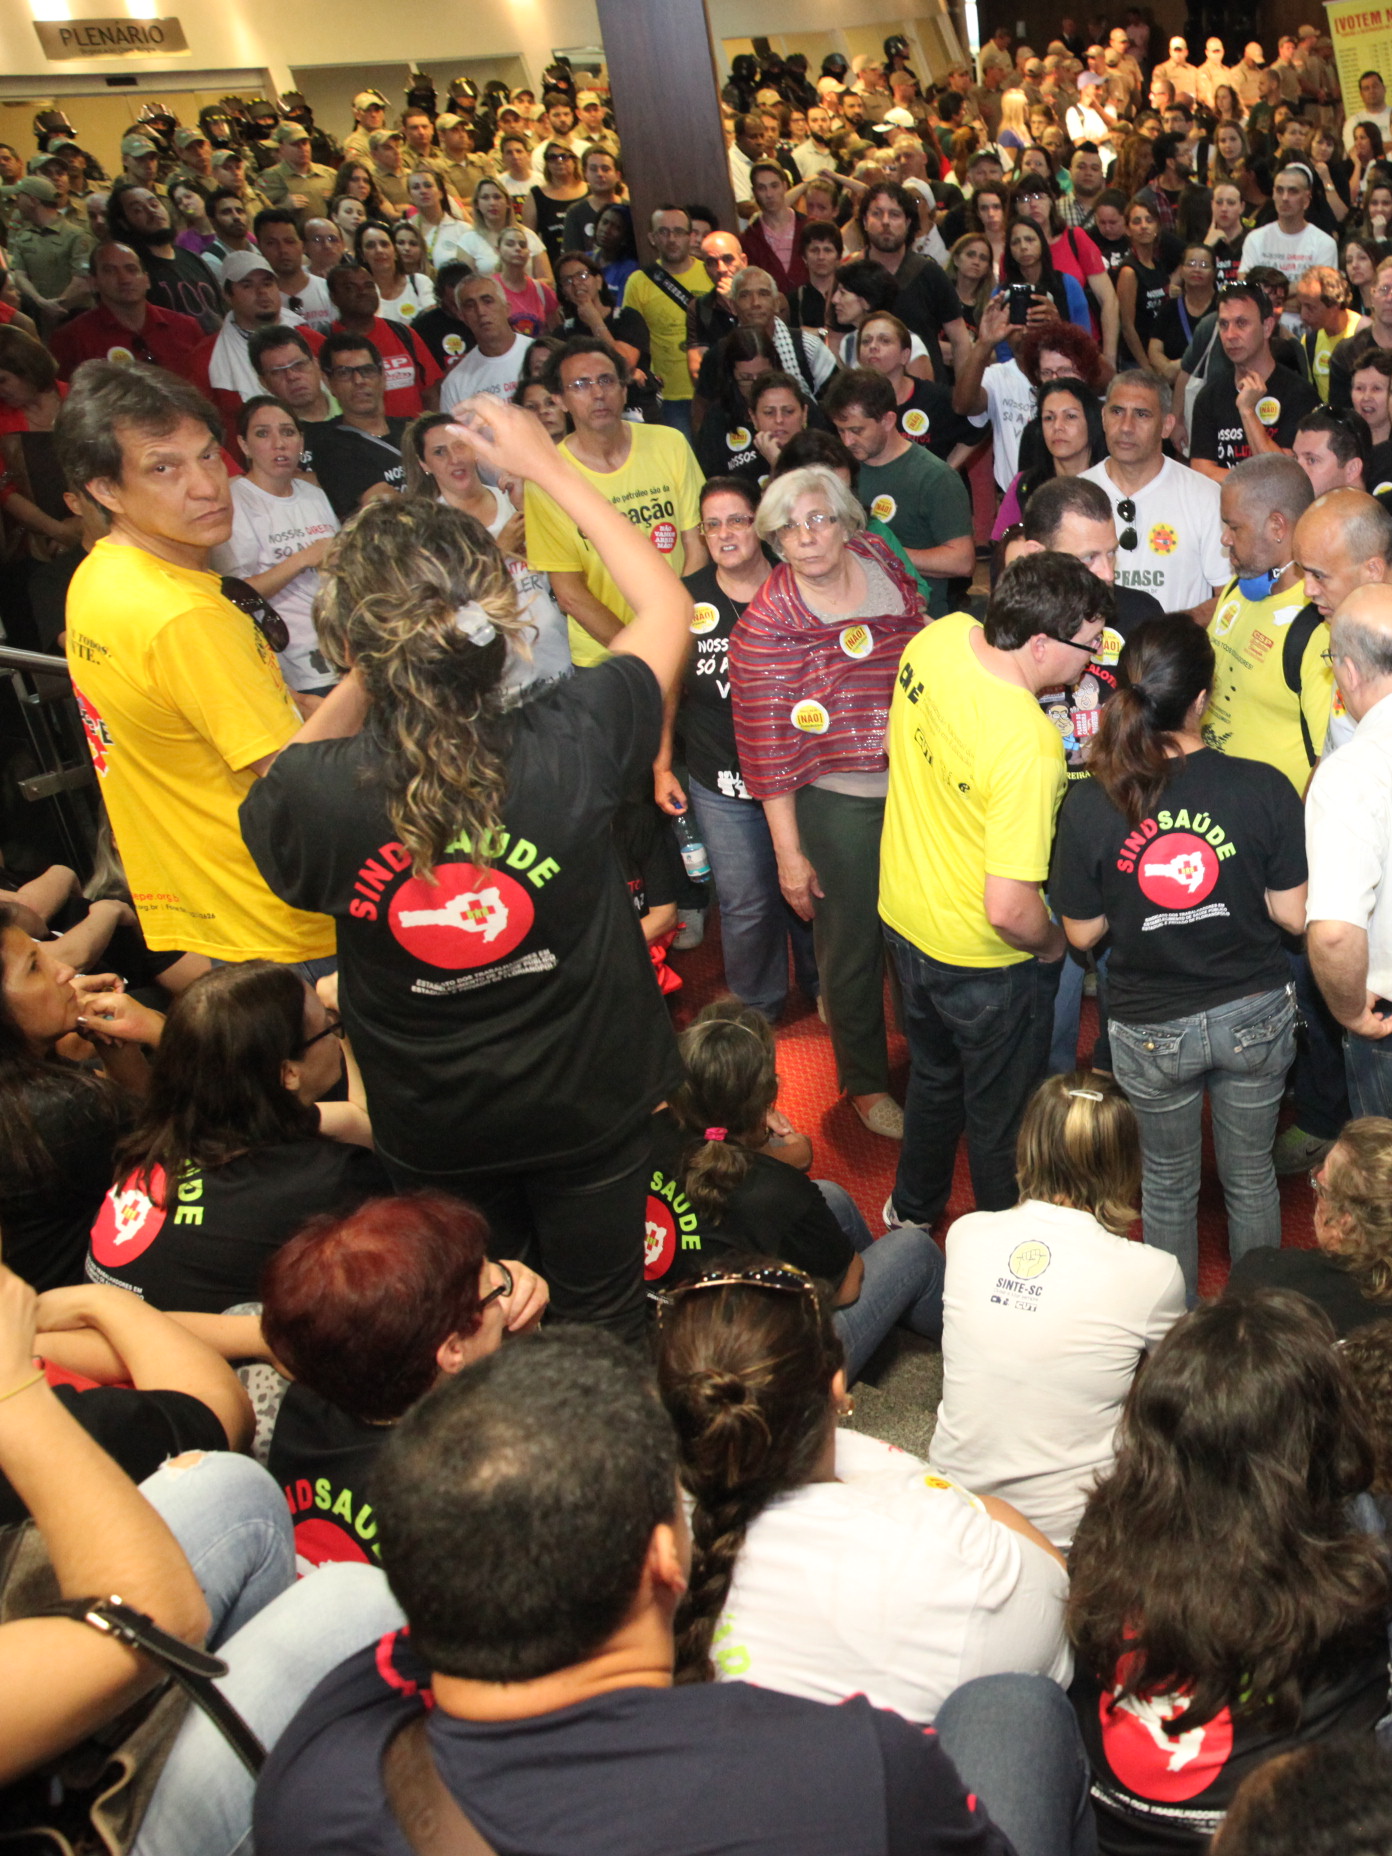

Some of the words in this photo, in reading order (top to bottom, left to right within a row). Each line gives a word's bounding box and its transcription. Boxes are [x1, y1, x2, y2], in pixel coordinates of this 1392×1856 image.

[59, 20, 165, 46] PLENÁRIO
[1217, 428, 1243, 441] SSOS
[696, 654, 717, 676] SÓ
[1116, 808, 1237, 874] SINDSAÚDE
[996, 1277, 1043, 1297] SINTE-SC
